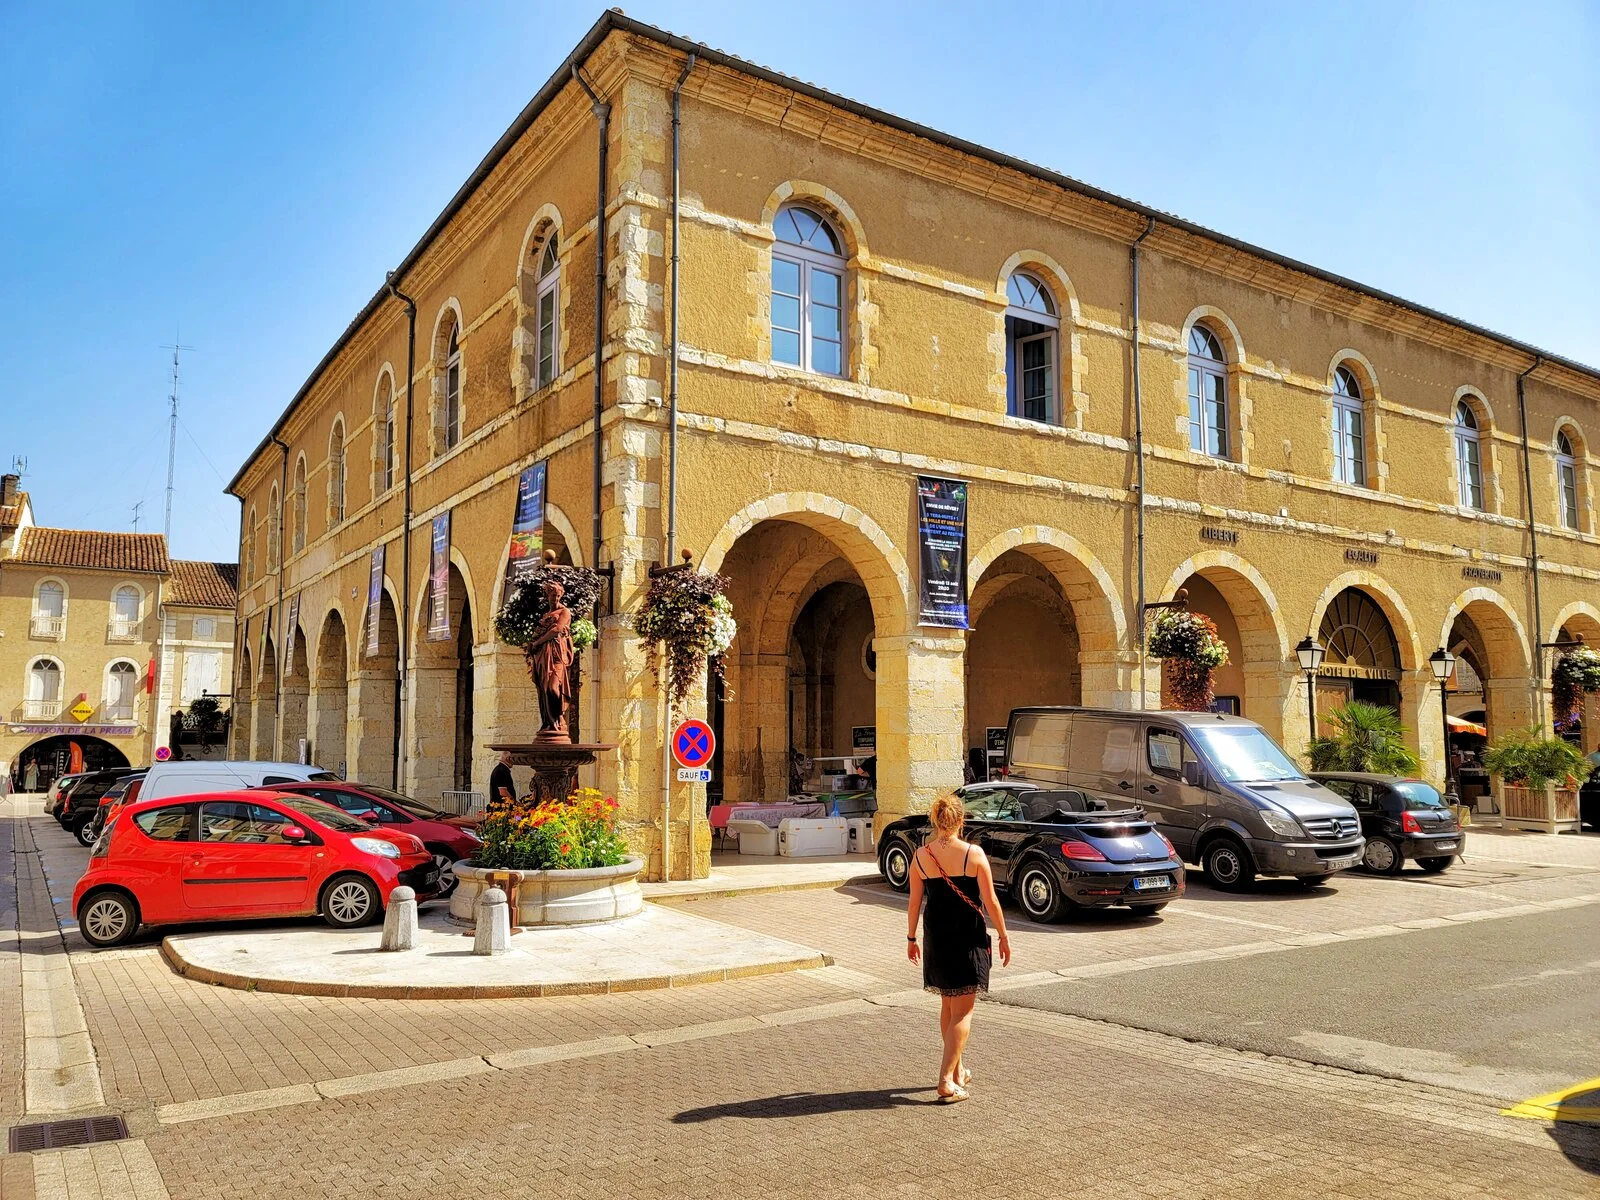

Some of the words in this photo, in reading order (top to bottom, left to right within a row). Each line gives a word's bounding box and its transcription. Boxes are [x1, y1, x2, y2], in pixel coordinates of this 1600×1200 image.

[1351, 667, 1362, 678] DE
[1368, 668, 1391, 679] VILLE
[24, 726, 65, 734] MAISON
[68, 726, 81, 734] DE
[84, 726, 96, 734] LA
[100, 726, 133, 734] PRESSE
[680, 771, 698, 779] SAUF
